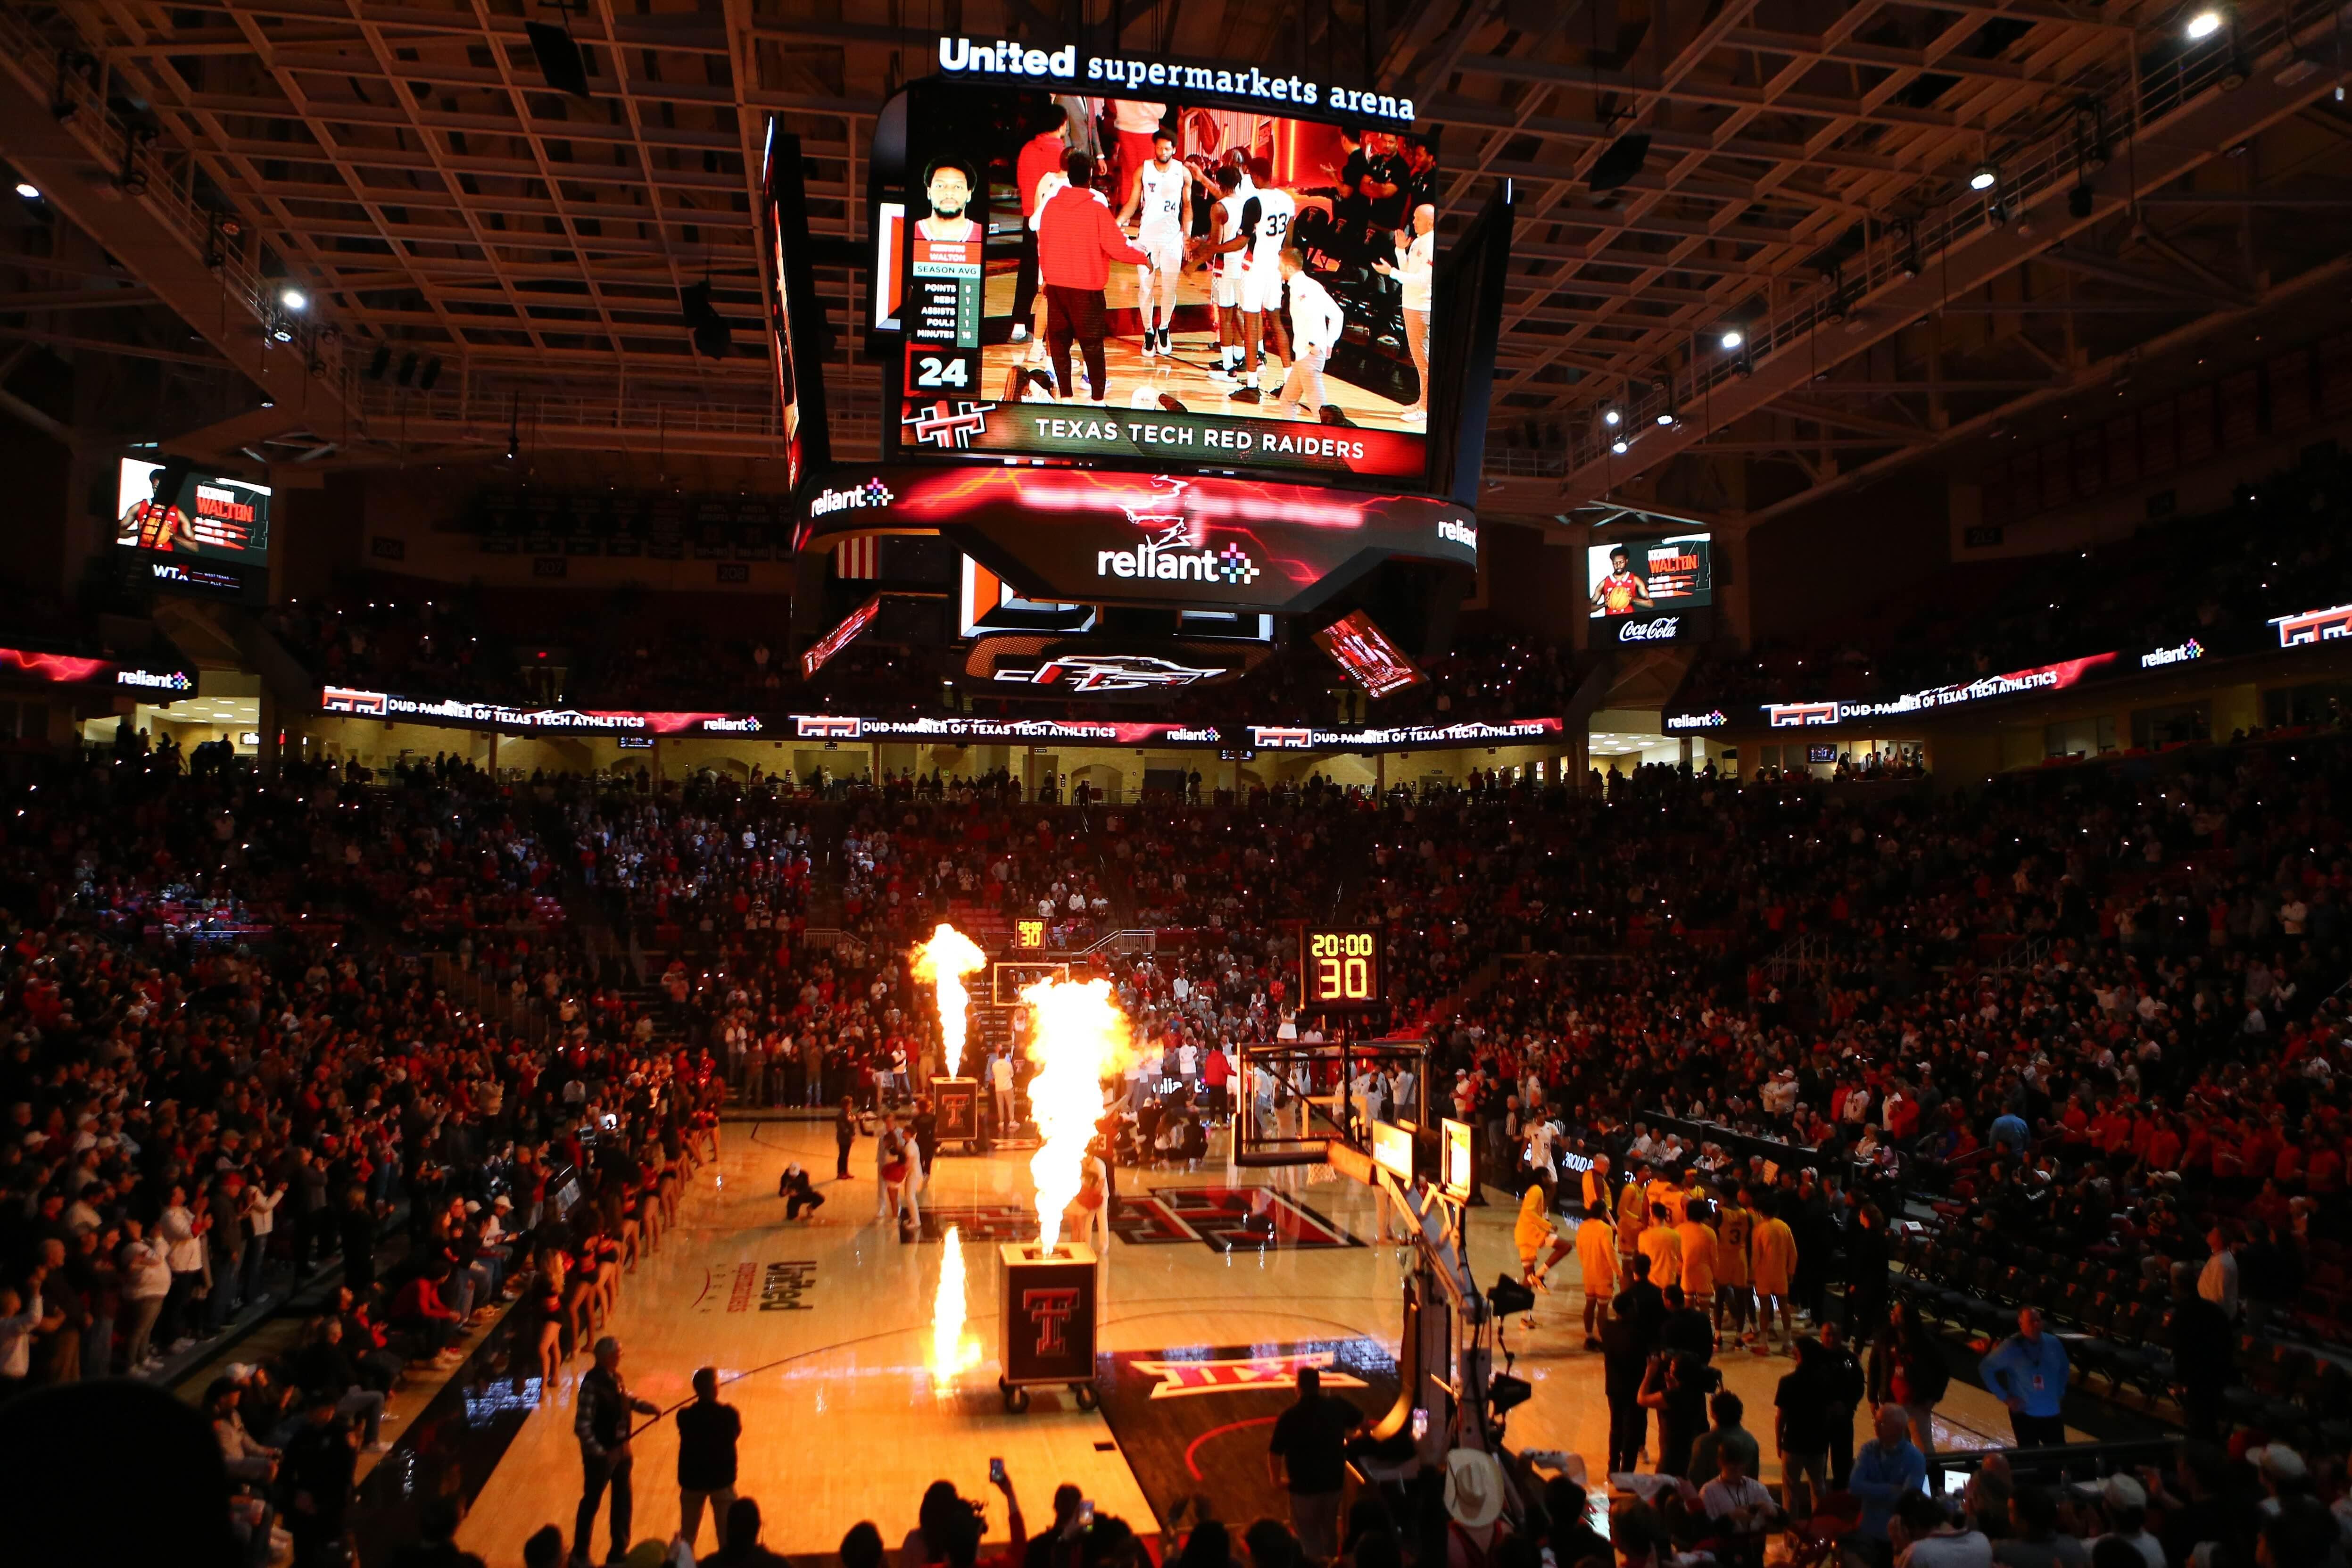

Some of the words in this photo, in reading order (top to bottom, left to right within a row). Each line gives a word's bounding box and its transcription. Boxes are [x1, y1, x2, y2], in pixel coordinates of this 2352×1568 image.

[938, 37, 1076, 77] United
[1087, 57, 1318, 105] supermarkets
[1329, 87, 1415, 121] arena
[1164, 201, 1176, 212] 24
[1266, 213, 1287, 237] 33
[929, 253, 966, 262] WALTON
[918, 265, 955, 274] SEASON
[925, 284, 956, 292] POINTS
[933, 295, 956, 304] REBS
[965, 296, 970, 305] 1
[921, 307, 955, 316] ASSISTS
[965, 308, 969, 316] 1
[927, 318, 955, 327] FOULS
[965, 319, 969, 328] 1
[917, 329, 955, 339] MINUTES
[919, 357, 968, 387] 24
[1035, 418, 1118, 441] TEXAS
[1127, 423, 1193, 446] TECH
[1203, 427, 1252, 450] RED
[1262, 432, 1364, 459] RAIDERS
[197, 497, 253, 522] WALTON
[812, 485, 867, 518] reliant
[1097, 543, 1221, 583] reliant
[1649, 555, 1697, 573] WALTON
[2141, 644, 2188, 668] reliant
[117, 670, 174, 689] reliant
[1922, 695, 1935, 708] OF
[1937, 689, 1968, 705] TEXAS
[1970, 682, 1997, 699] TECH
[1998, 671, 2057, 694] ATHLETICS
[474, 708, 491, 721] OF
[494, 710, 532, 725] TEXAS
[534, 713, 570, 727] TECH
[572, 715, 645, 728] ATHLETICS
[704, 717, 748, 731] reliant
[1668, 713, 1712, 729] reliant
[951, 724, 968, 734] OF
[970, 724, 1011, 735] TEXAS
[1015, 726, 1046, 736] TECH
[1050, 726, 1117, 738] ATHLETICS
[1167, 729, 1208, 741] reliant
[1391, 731, 1407, 742] OF
[1410, 730, 1444, 741] TEXAS
[1449, 727, 1477, 739] TECH
[1479, 723, 1544, 737] ATHLETICS
[1019, 921, 1043, 931] 20:00
[1021, 931, 1040, 947] 30
[1312, 934, 1373, 957] 20:00
[1320, 958, 1367, 999] 30
